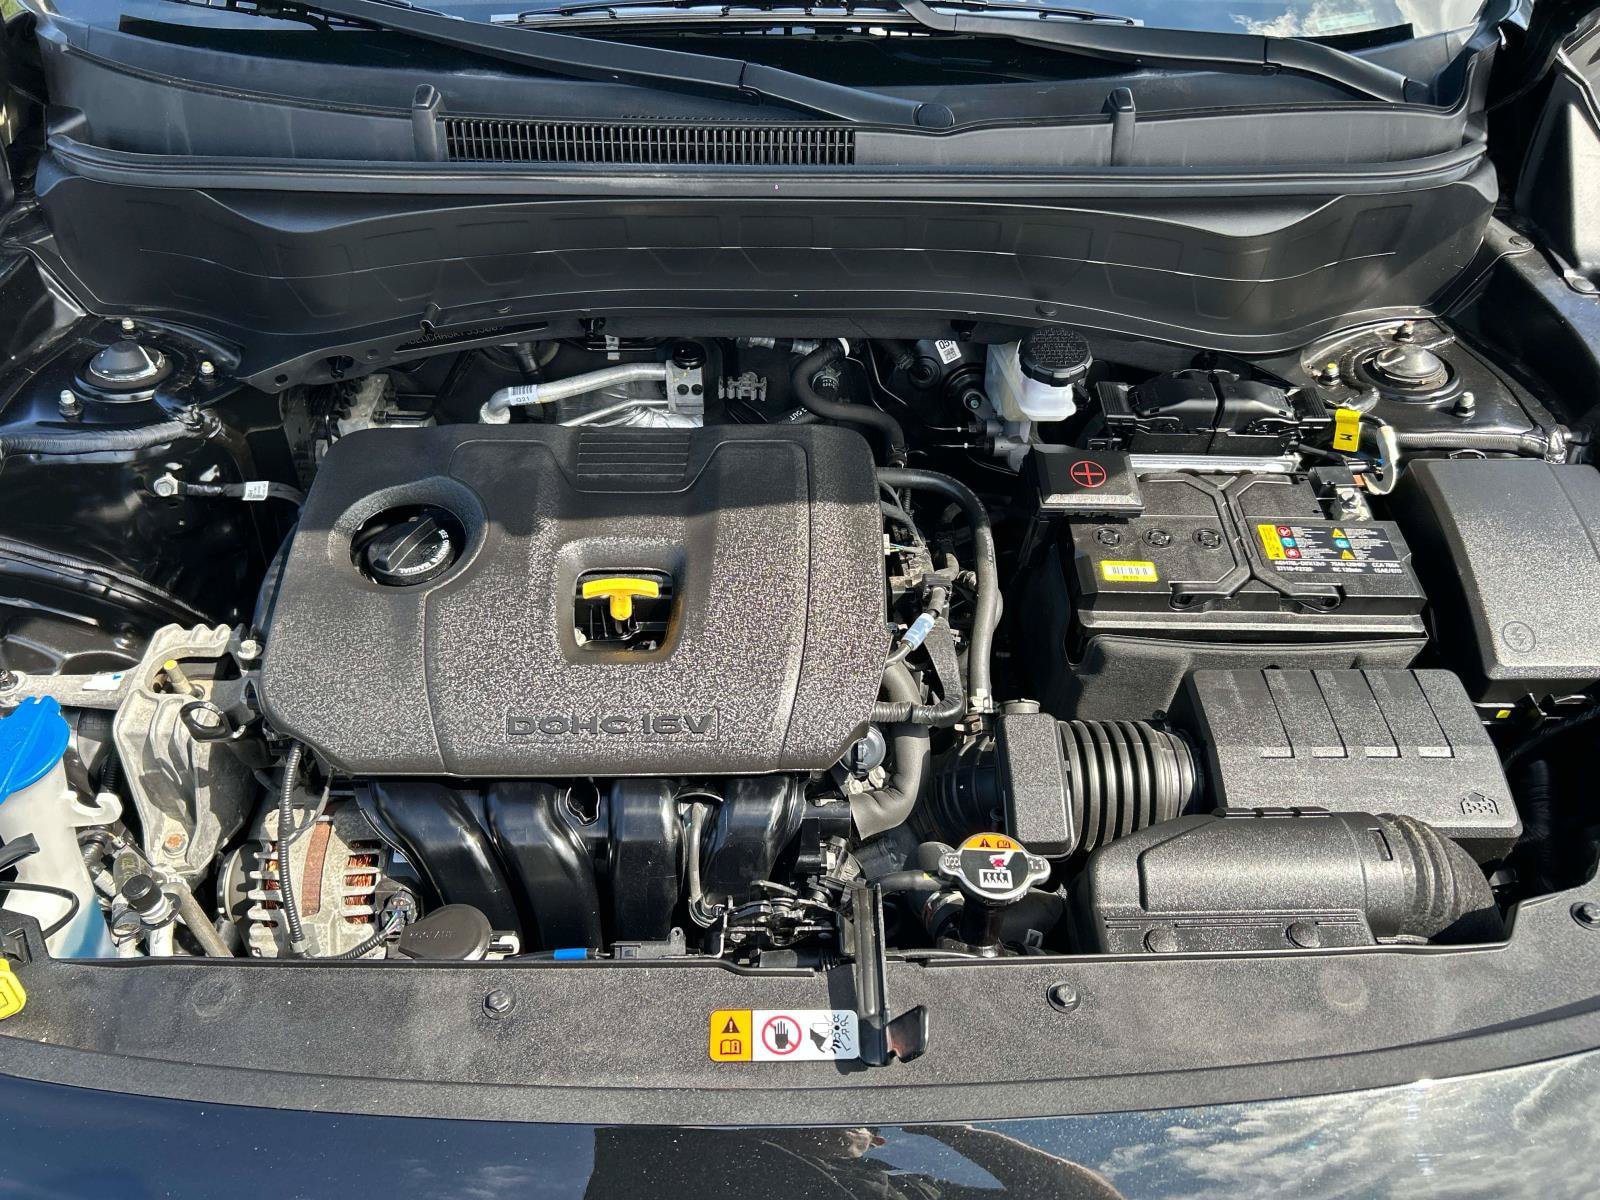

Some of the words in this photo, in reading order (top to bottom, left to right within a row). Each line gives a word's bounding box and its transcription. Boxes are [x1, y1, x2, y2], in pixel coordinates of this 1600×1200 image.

[1339, 433, 1353, 441] M
[438, 529, 449, 540] SEE
[398, 561, 431, 573] MANUAL
[508, 714, 632, 735] DOHC
[642, 714, 711, 735] 16V
